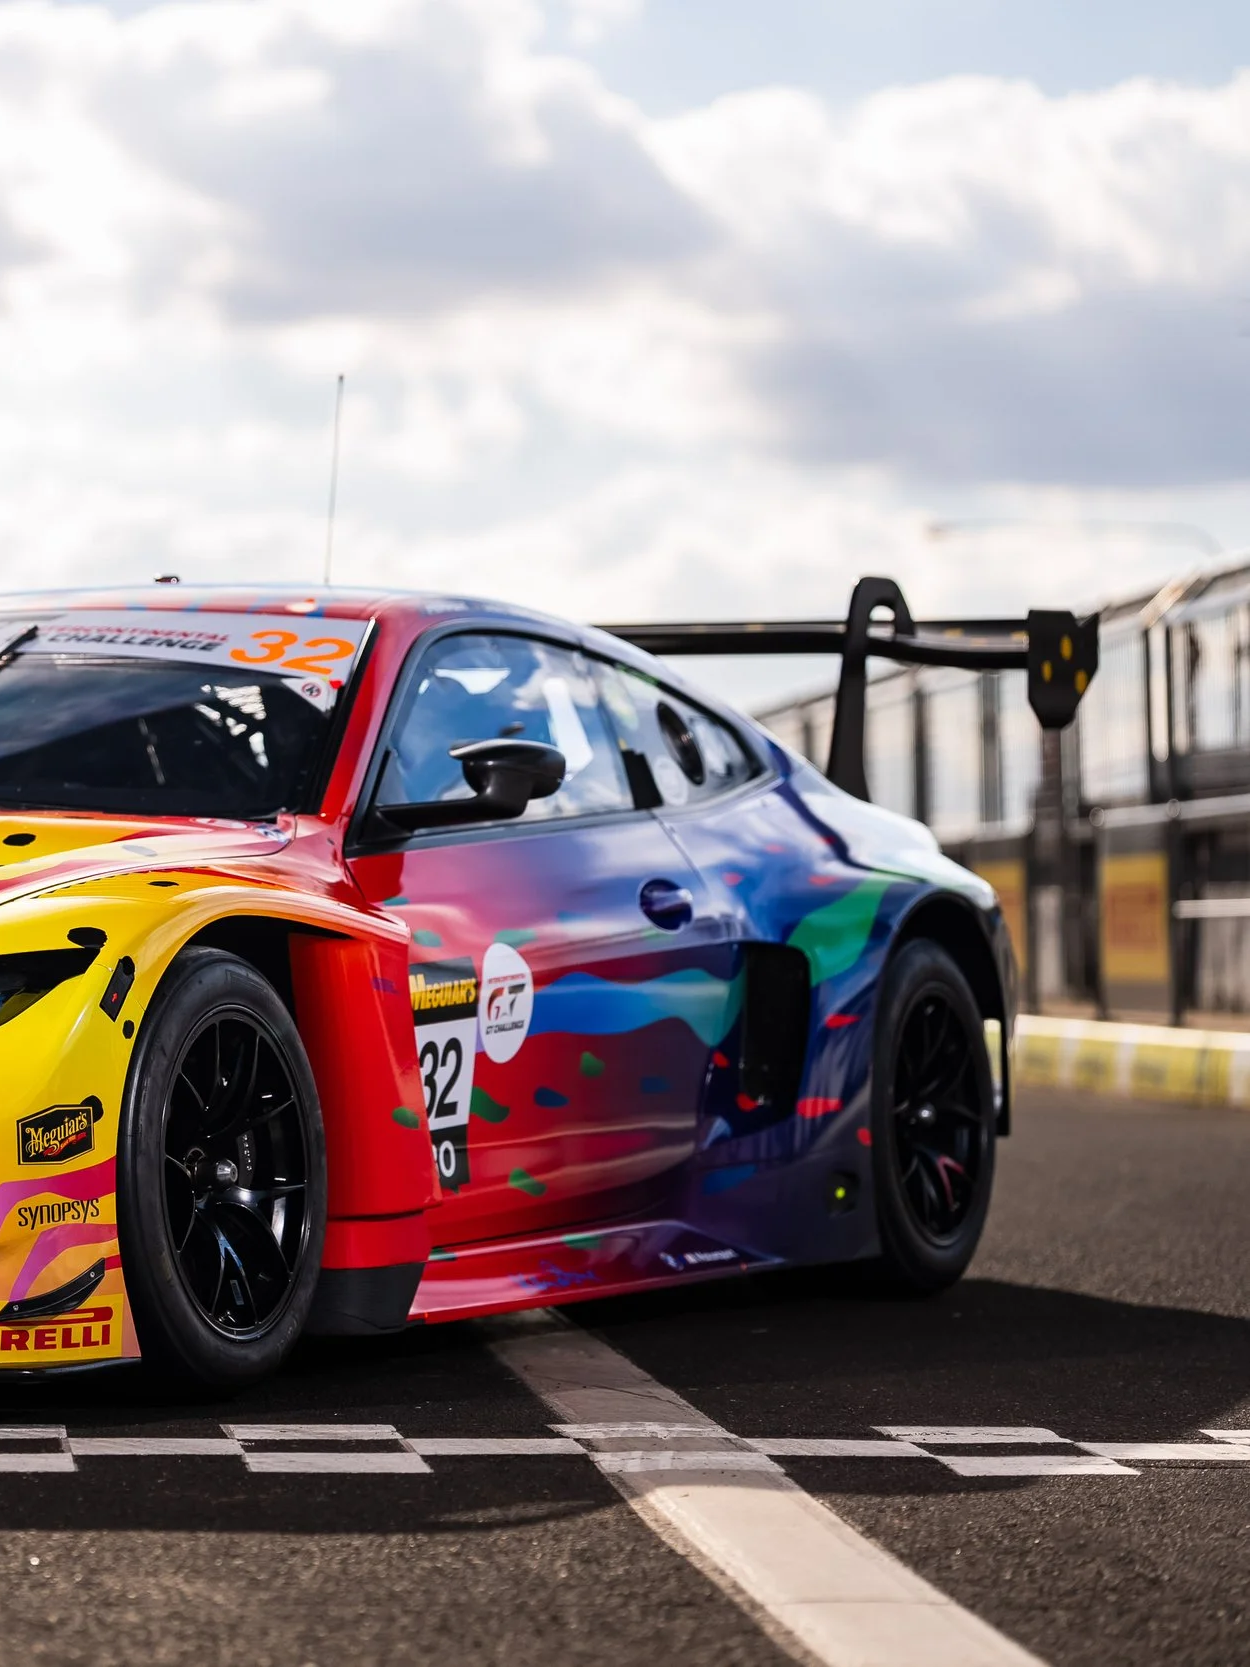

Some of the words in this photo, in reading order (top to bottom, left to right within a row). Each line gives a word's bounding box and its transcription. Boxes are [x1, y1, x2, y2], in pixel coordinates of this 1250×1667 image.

[50, 633, 223, 651] CHALLENGE
[230, 630, 355, 675] 32
[419, 1037, 462, 1119] 32
[25, 1111, 88, 1157] Meguiar's
